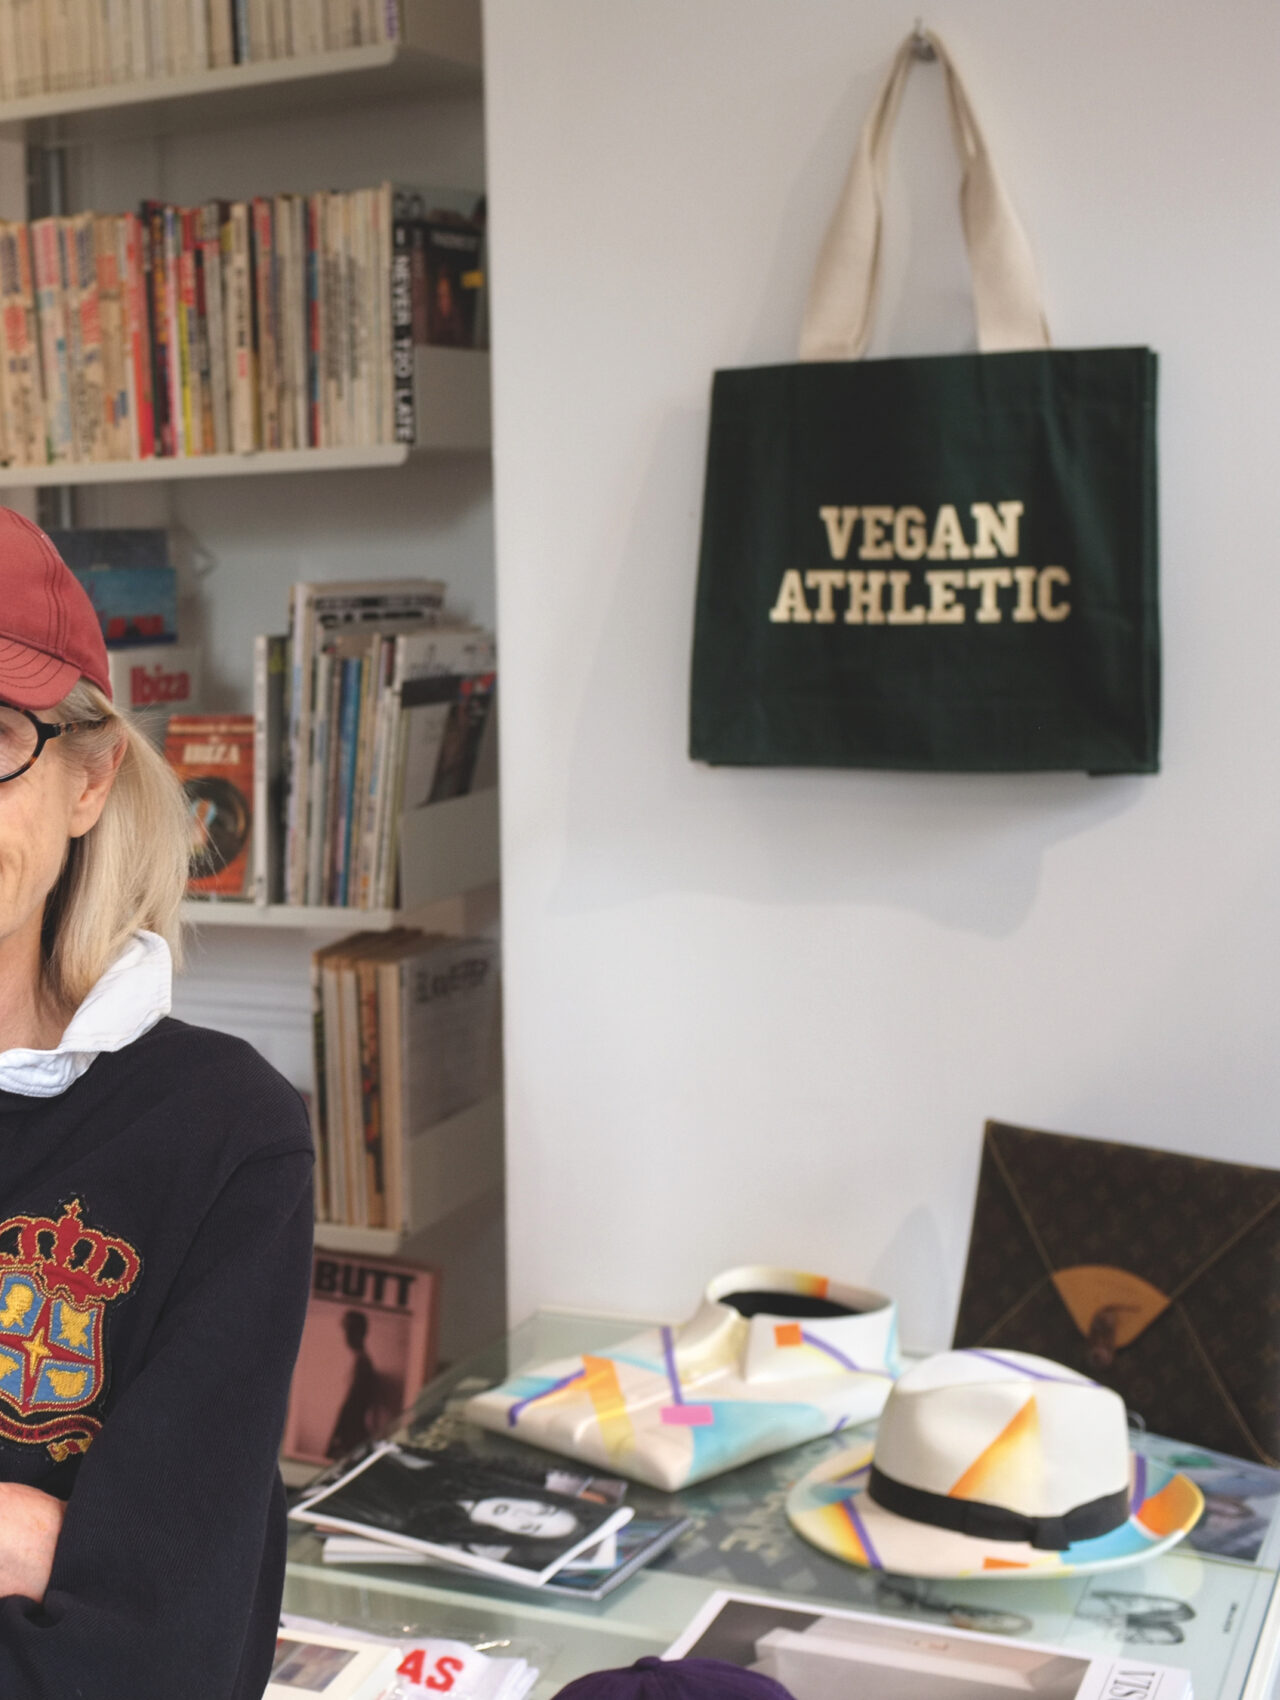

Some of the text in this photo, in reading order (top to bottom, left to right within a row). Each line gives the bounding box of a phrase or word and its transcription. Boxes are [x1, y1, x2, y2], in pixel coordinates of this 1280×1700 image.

[820, 500, 1024, 560] VEGAN
[770, 566, 1071, 625] ATHLETIC
[130, 664, 190, 706] Ibiza
[314, 1260, 417, 1306] BUTT
[396, 1649, 464, 1693] AS
[1109, 1671, 1156, 1700] VIS
